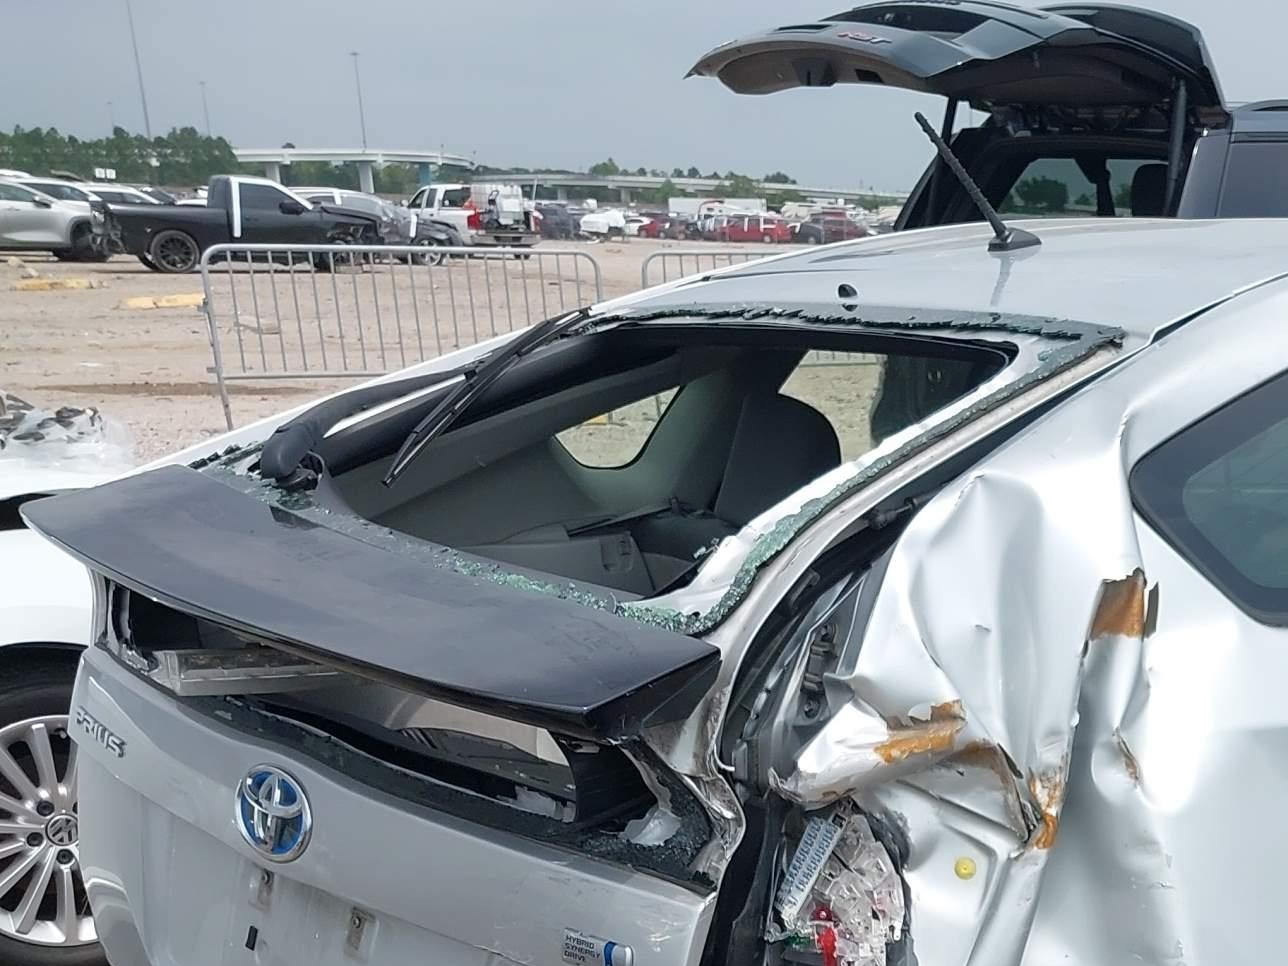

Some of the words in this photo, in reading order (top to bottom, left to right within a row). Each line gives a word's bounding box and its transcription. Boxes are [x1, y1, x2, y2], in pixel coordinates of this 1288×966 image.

[76, 705, 127, 758] PRIUS
[564, 942, 601, 959] SYNERGY
[565, 934, 595, 950] HYBRID
